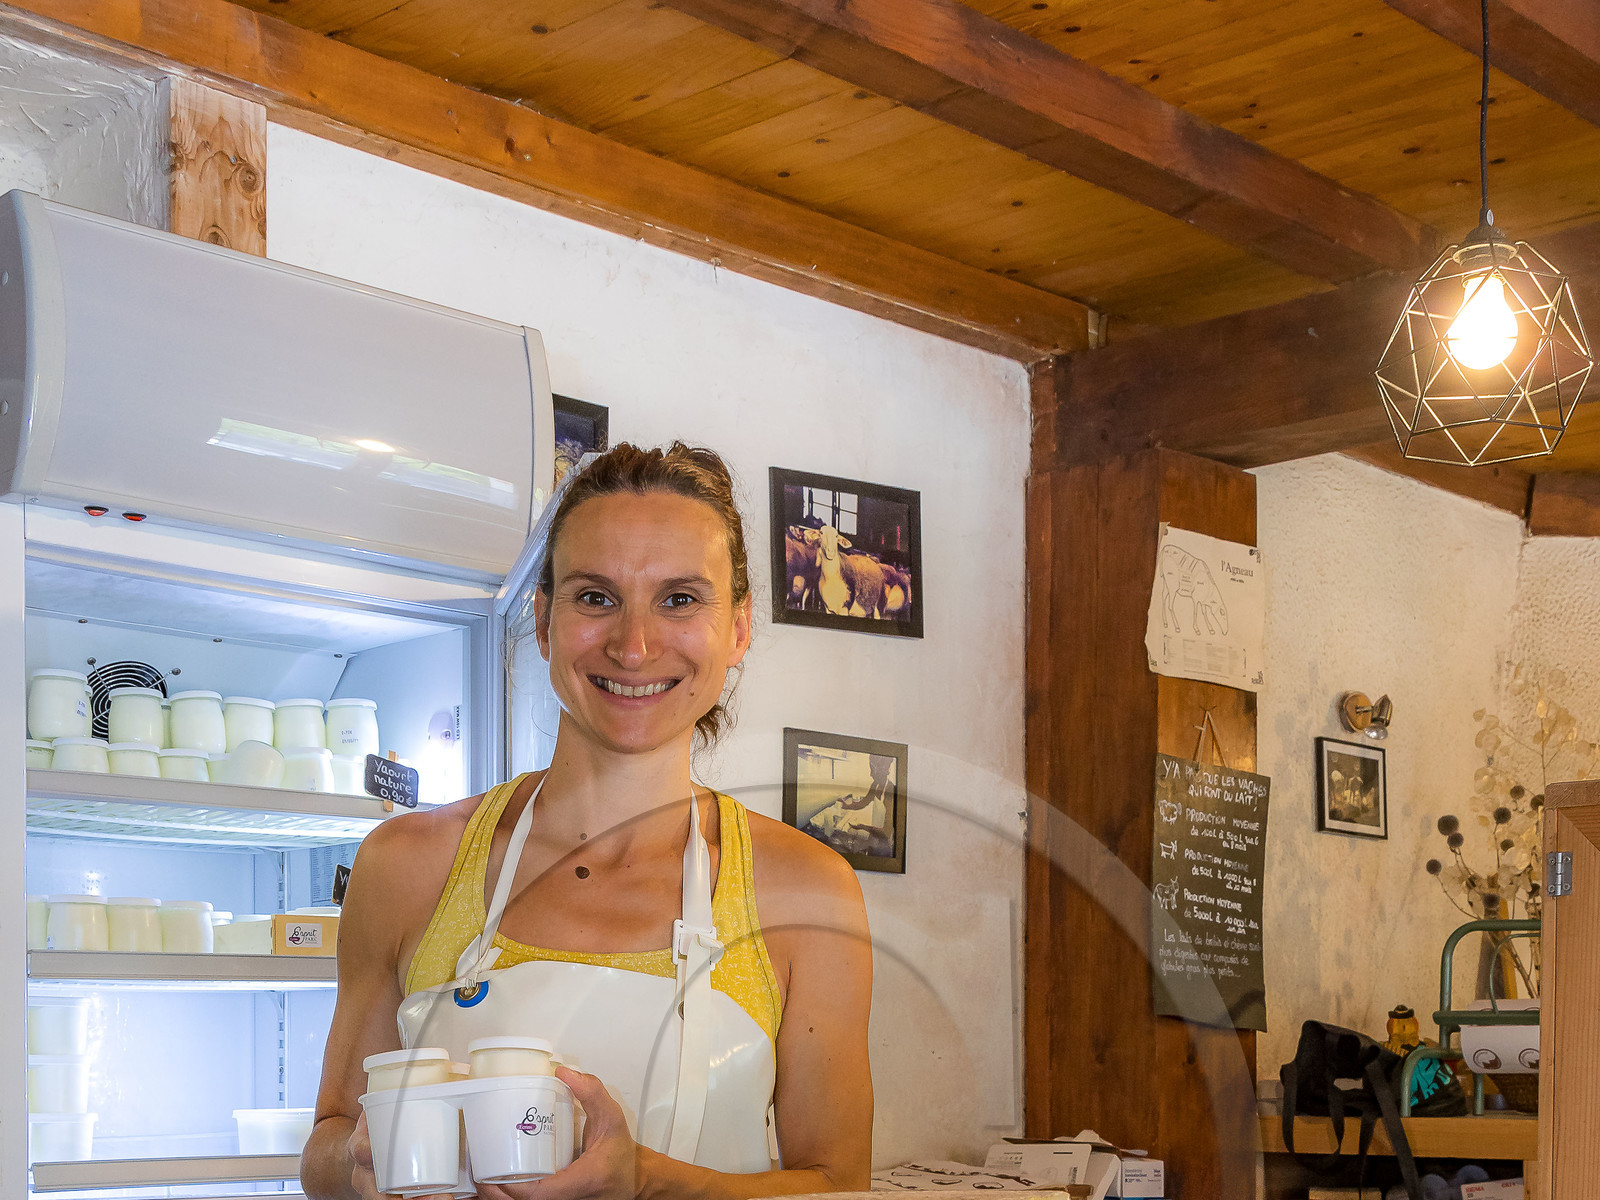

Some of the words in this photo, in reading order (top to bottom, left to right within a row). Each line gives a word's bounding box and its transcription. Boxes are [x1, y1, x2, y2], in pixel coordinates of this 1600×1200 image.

[374, 760, 412, 782] Yaourt
[374, 774, 414, 794] nature
[1204, 786, 1222, 799] FONT
[1222, 776, 1235, 786] LES
[1238, 778, 1266, 797] VACHES
[1186, 808, 1226, 824] PRODUCTION
[1232, 818, 1260, 832] MOYENNE
[1184, 848, 1221, 865] PRODUCTION
[1217, 897, 1242, 912] MOYENNE
[1164, 928, 1175, 942] Les
